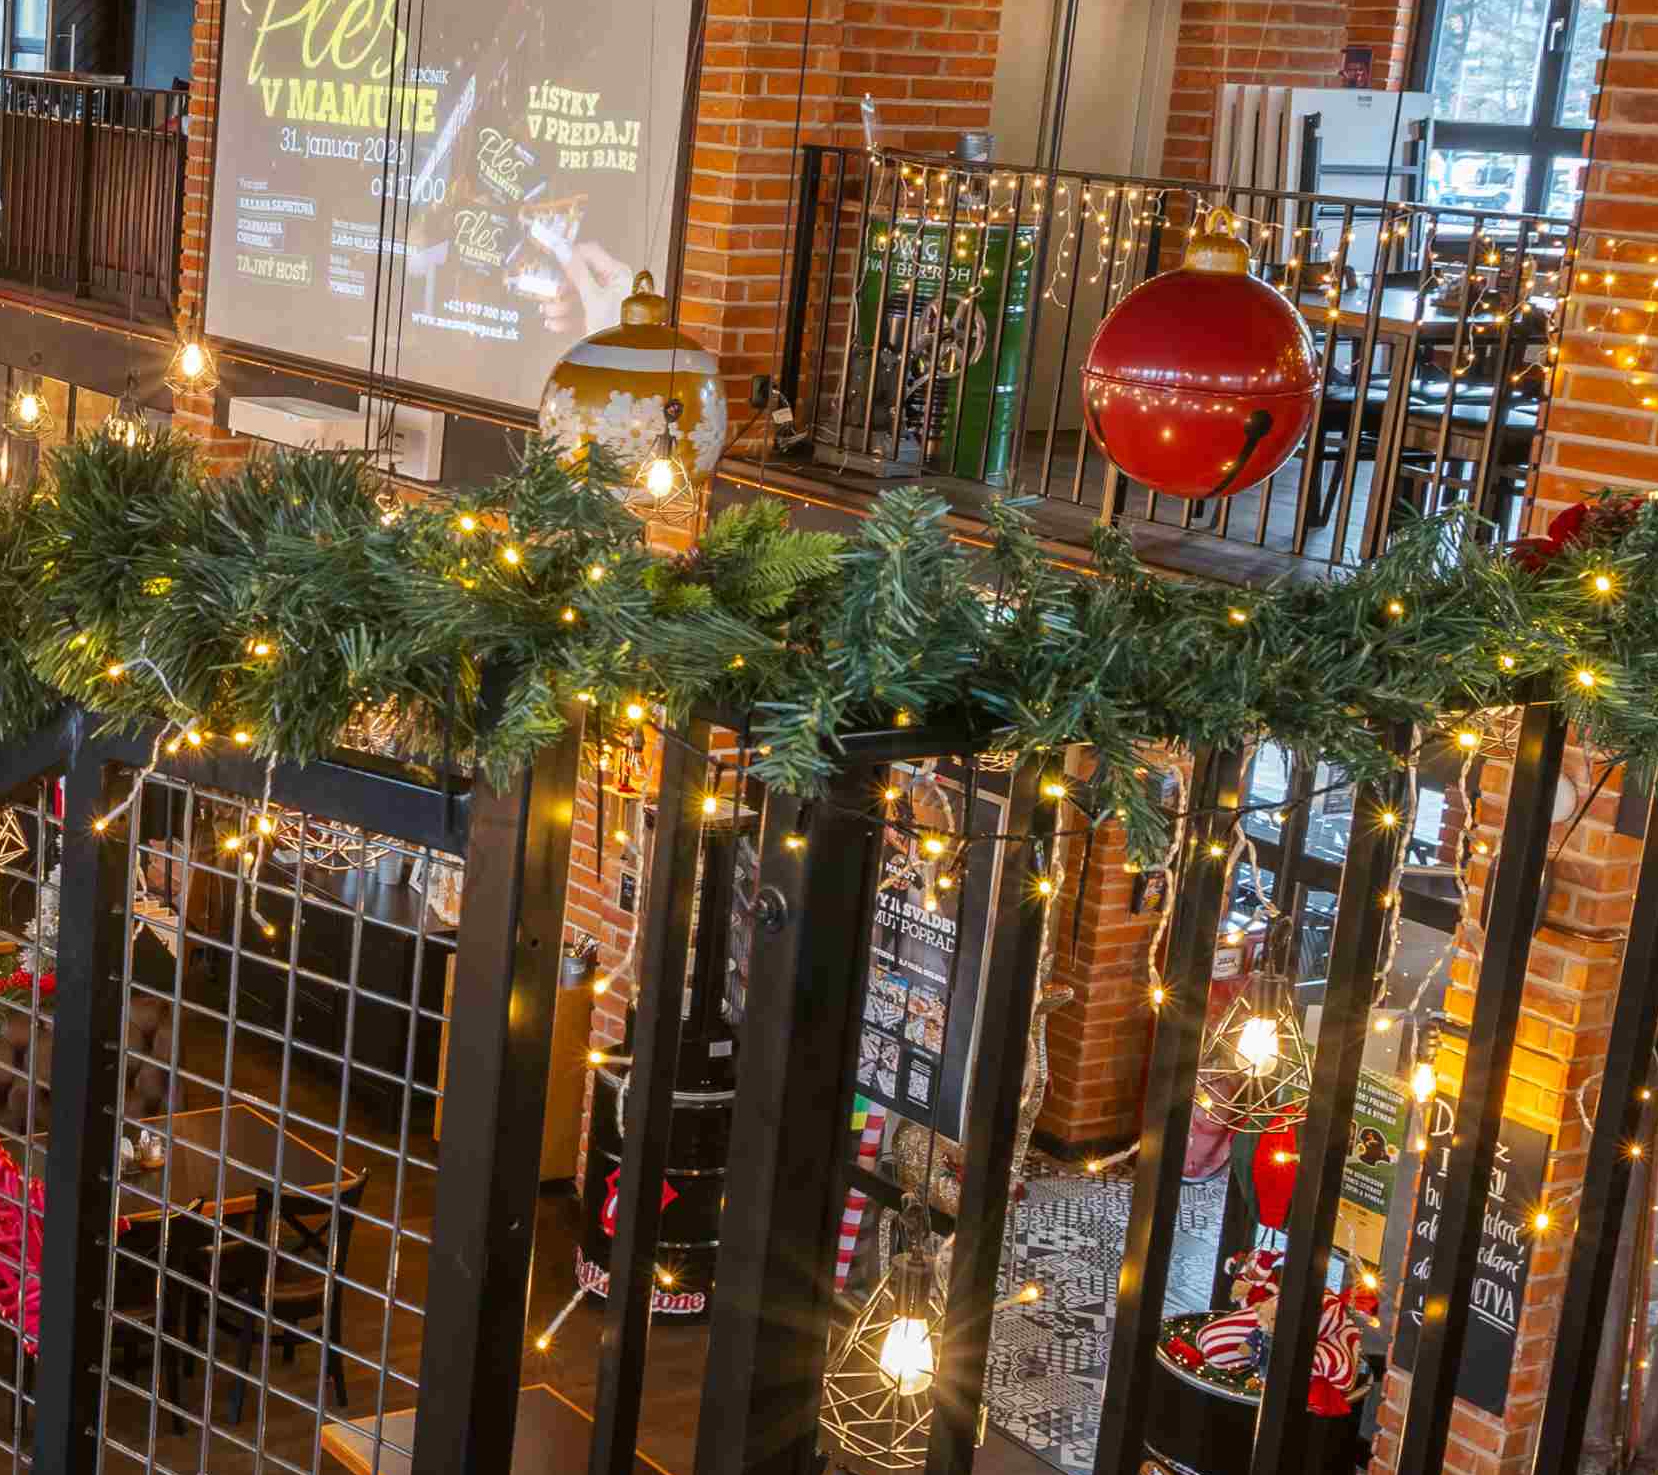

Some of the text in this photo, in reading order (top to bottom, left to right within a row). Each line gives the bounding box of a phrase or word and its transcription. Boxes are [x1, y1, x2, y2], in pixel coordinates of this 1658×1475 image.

[260, 77, 438, 133] V MAMUTE
[529, 79, 600, 117] LÍSTKY
[280, 126, 301, 153] 31.
[304, 131, 361, 161] január
[527, 114, 641, 147] V PREDAJI
[477, 127, 526, 182] Ples
[559, 148, 637, 173] PRI BARE
[454, 210, 503, 253] Ples
[236, 254, 275, 277] TAJNÝ
